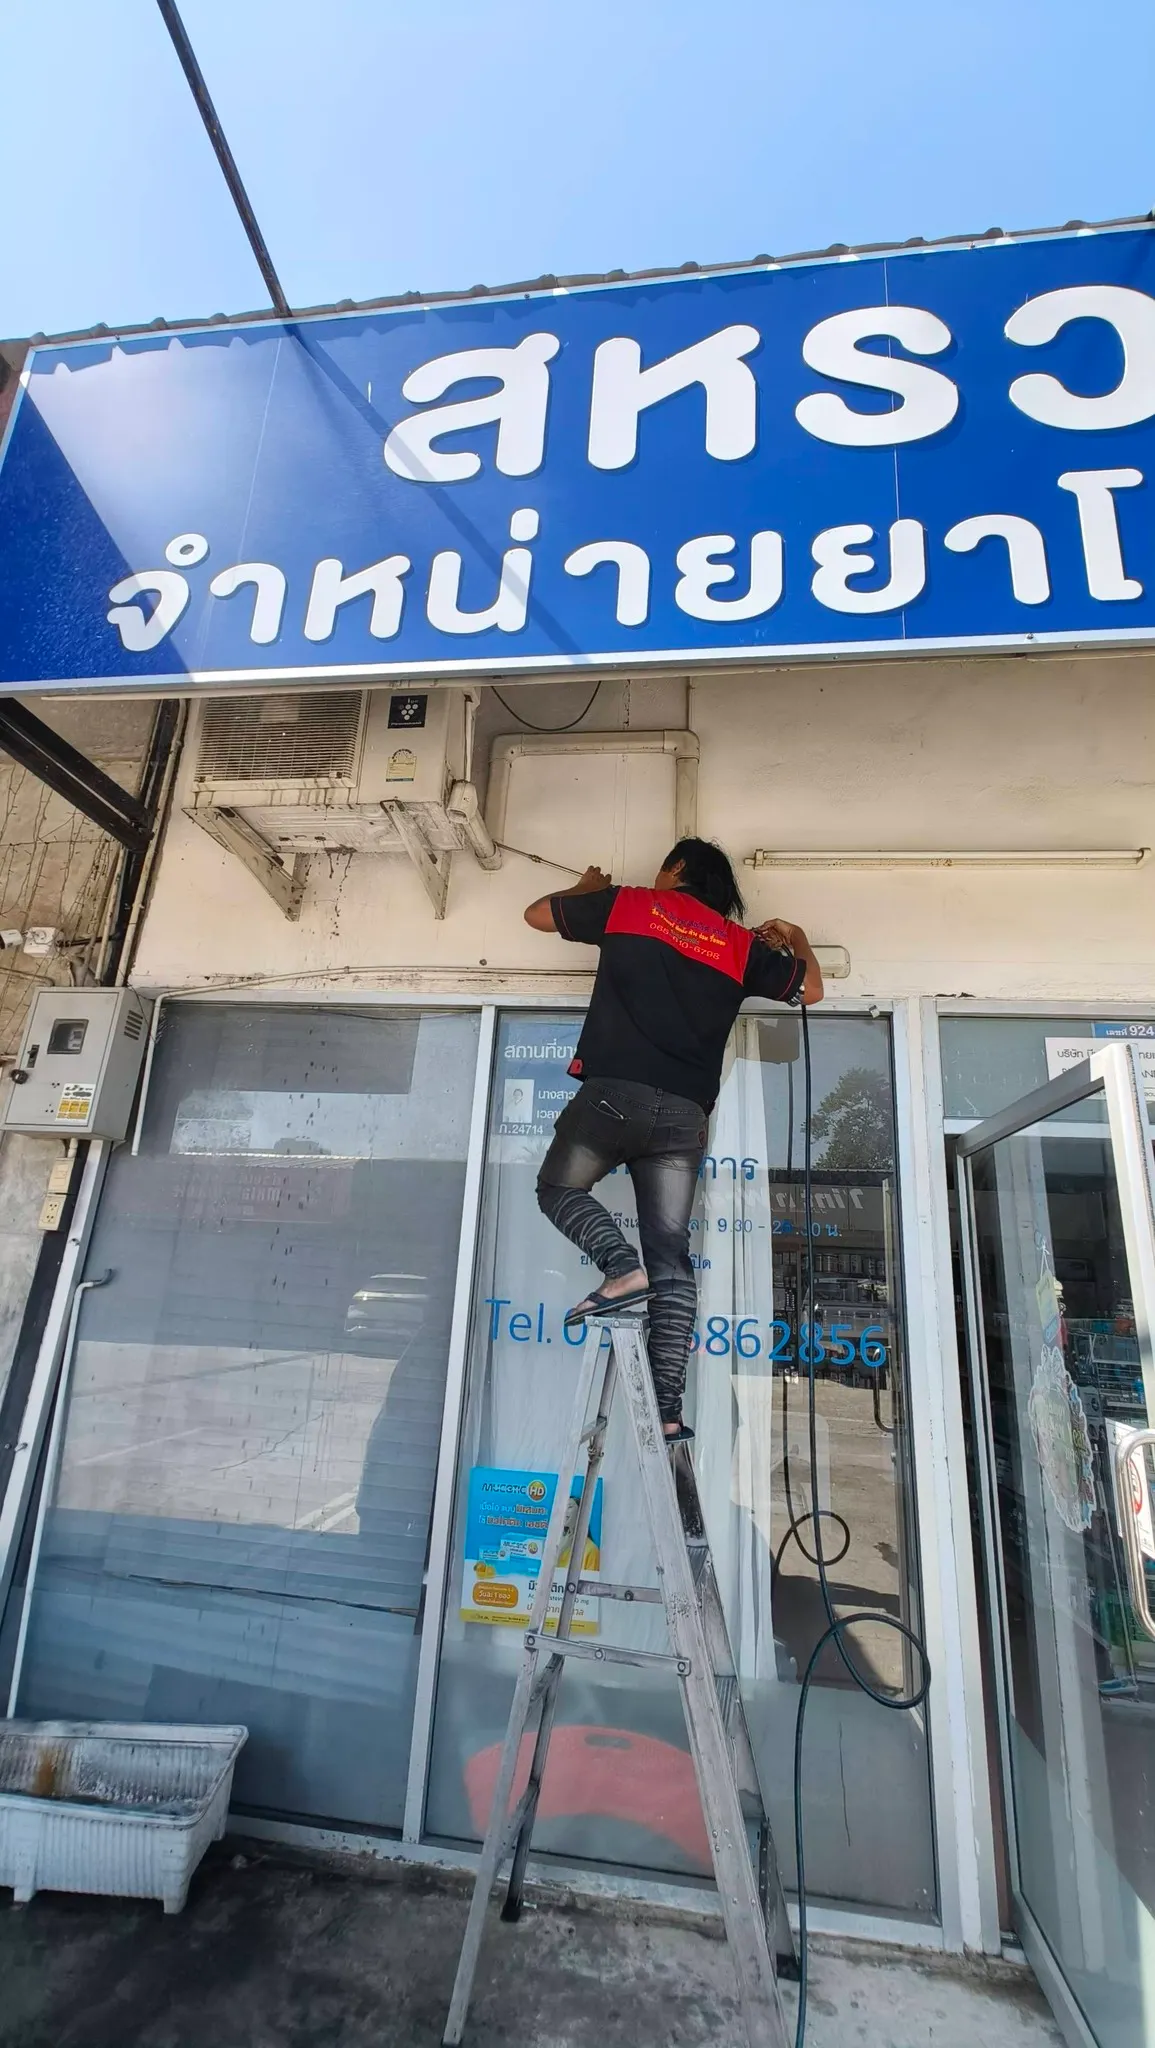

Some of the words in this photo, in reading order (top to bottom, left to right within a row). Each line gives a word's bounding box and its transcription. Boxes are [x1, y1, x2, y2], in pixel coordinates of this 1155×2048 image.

[106, 468, 1144, 652] จำหน่ายยาโ
[504, 1039, 577, 1059] สถานที่ขา
[538, 1089, 578, 1100] นางสาว
[717, 1218, 753, 1233] 9.30
[485, 1299, 552, 1344] Tel.
